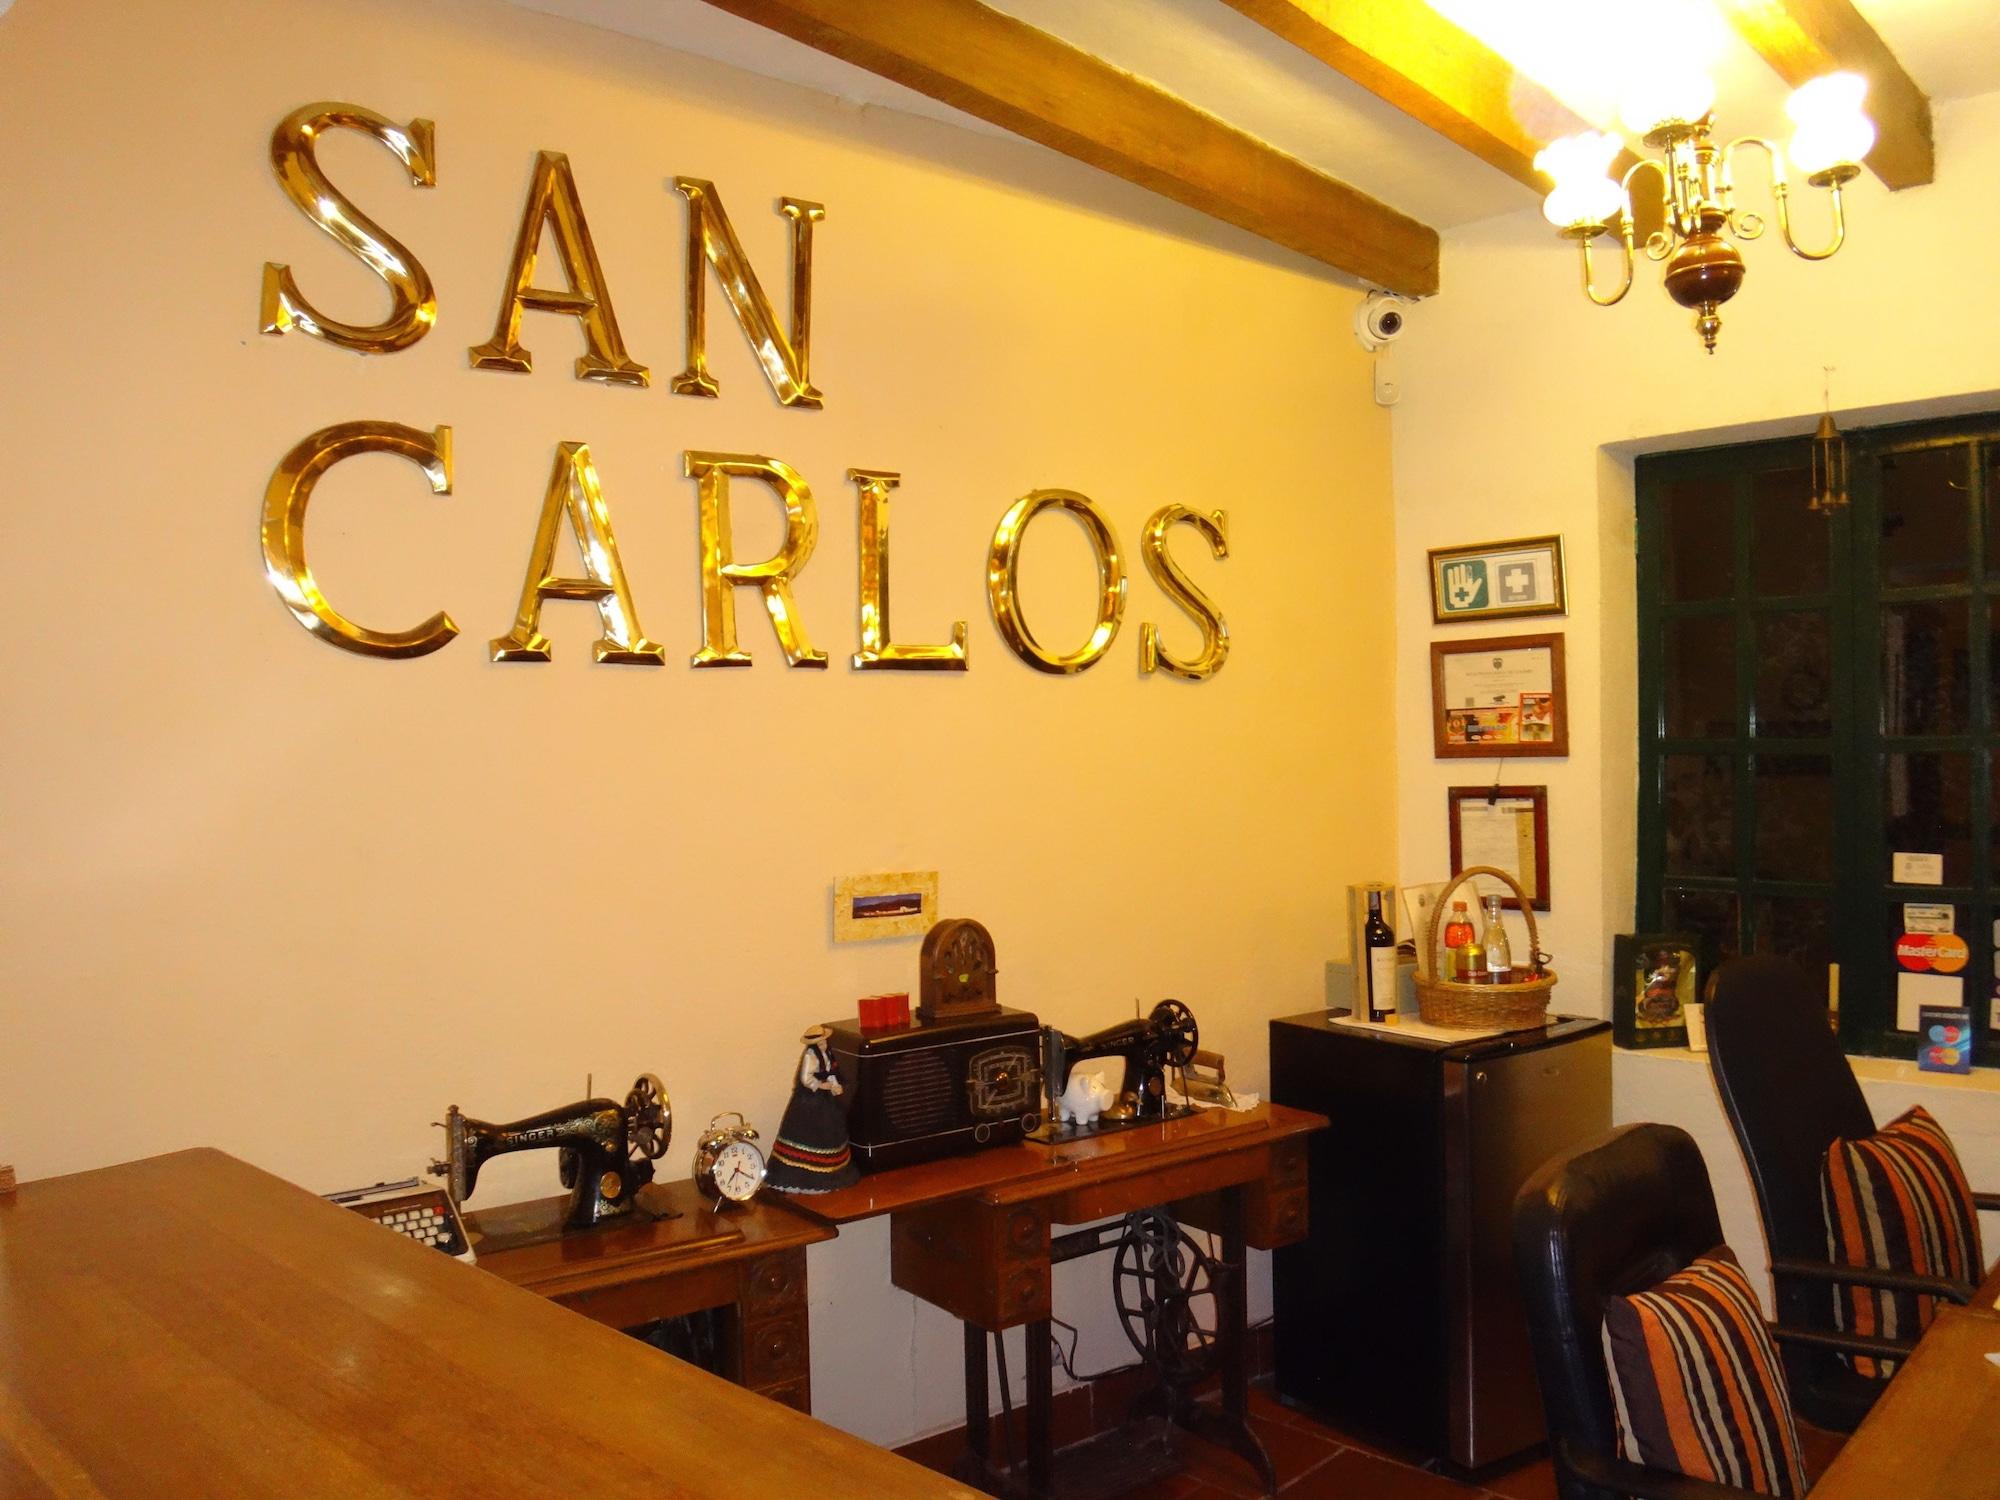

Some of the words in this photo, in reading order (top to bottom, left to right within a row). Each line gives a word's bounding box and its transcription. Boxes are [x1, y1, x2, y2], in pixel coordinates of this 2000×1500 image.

[260, 101, 825, 410] SAN
[260, 420, 1230, 682] CARLOS
[1896, 944, 1967, 958] MasterCard
[505, 1129, 554, 1144] SINGER
